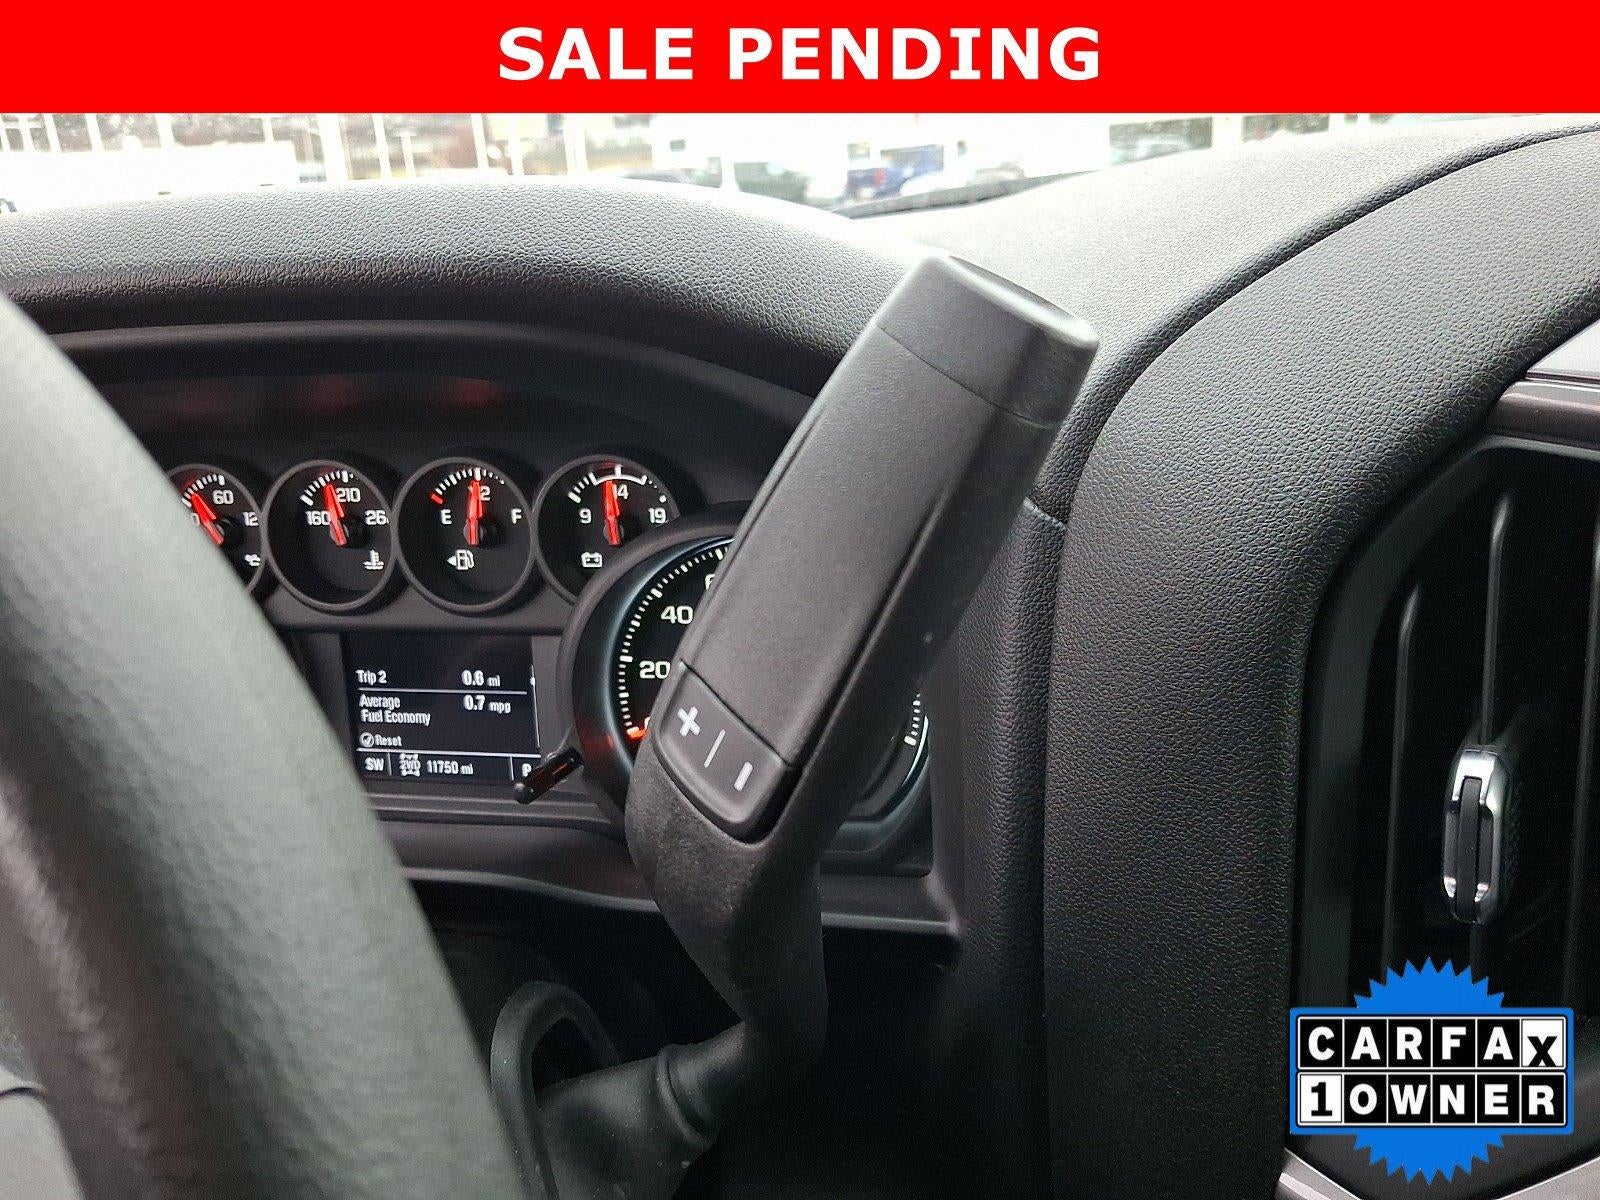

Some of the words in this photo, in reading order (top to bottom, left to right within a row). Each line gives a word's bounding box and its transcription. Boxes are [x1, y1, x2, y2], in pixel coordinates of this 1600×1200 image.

[212, 489, 235, 505] 60
[335, 487, 361, 503] 210
[305, 510, 332, 526] 160
[365, 510, 390, 526] 26
[441, 508, 452, 525] E
[511, 508, 523, 524] F
[579, 508, 592, 524] 9
[648, 507, 667, 524] 19
[660, 605, 694, 625] 40
[356, 669, 377, 686] Trip
[378, 670, 387, 684] 2
[461, 669, 485, 686] 0.6
[639, 660, 671, 680] 20
[359, 694, 401, 710] Average
[463, 694, 486, 711] 0.7
[488, 701, 512, 714] mpg
[360, 709, 383, 723] Fuel
[384, 710, 431, 727] Economy
[374, 734, 402, 747] Reset
[364, 757, 385, 772] SW
[426, 759, 460, 775] 11750
